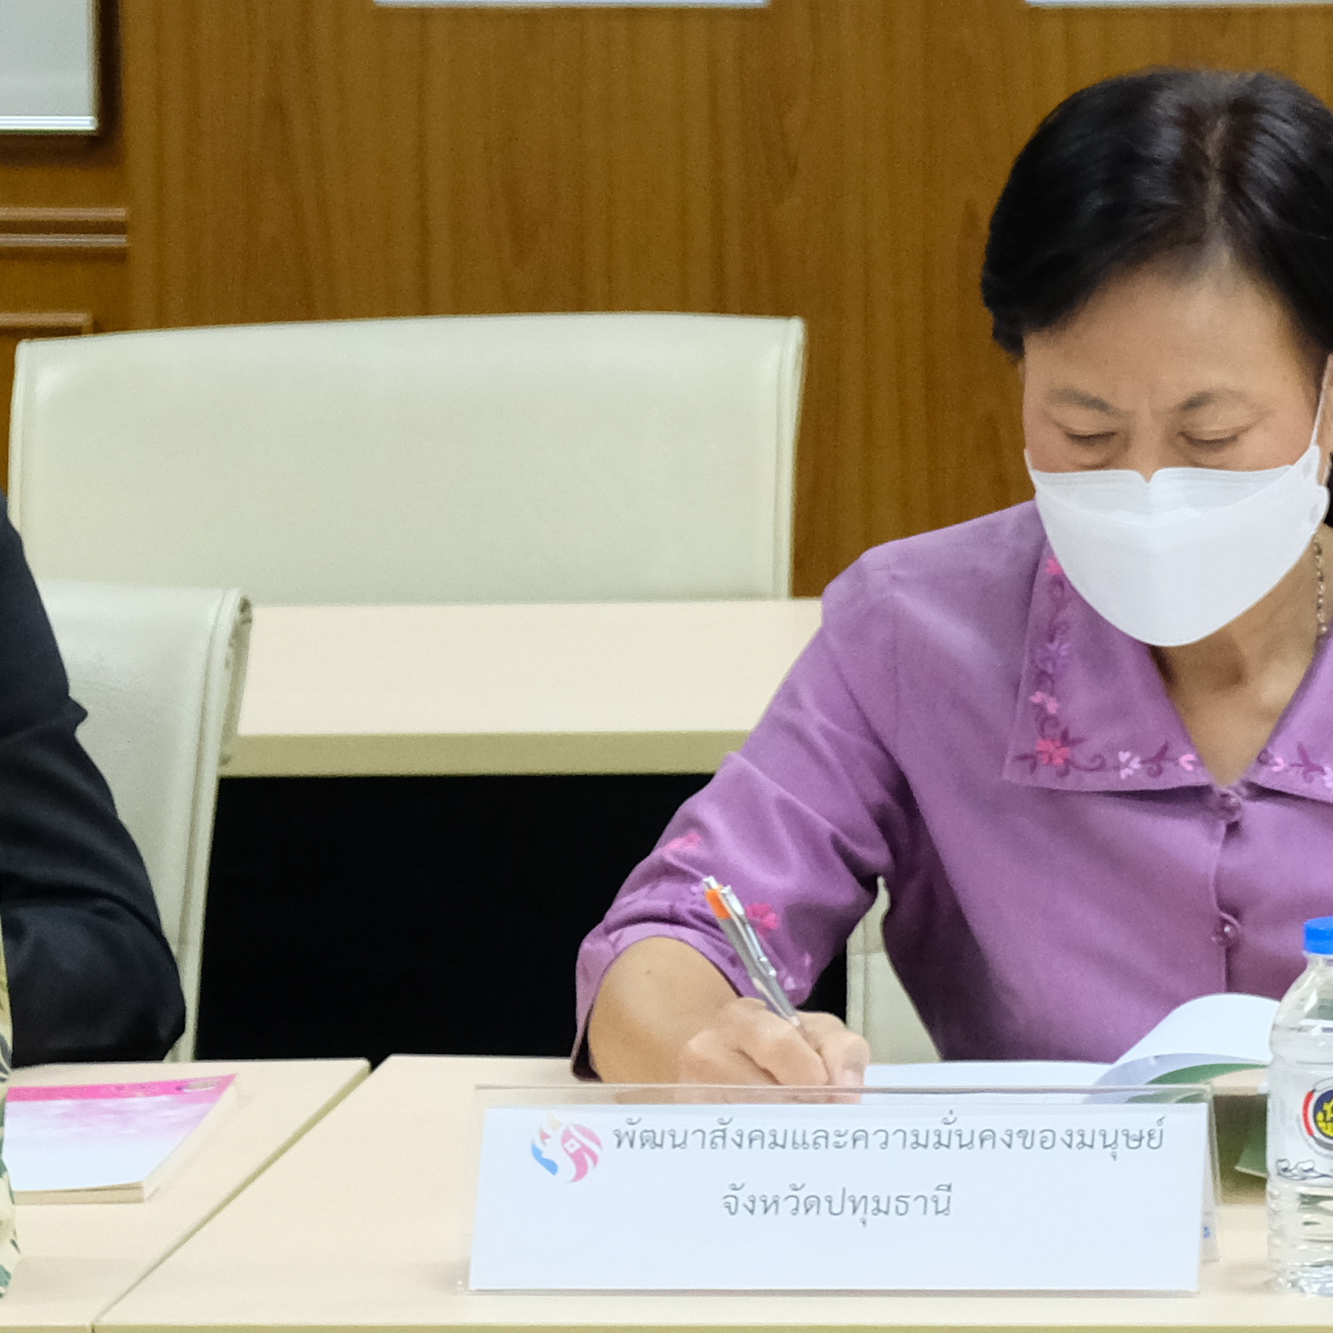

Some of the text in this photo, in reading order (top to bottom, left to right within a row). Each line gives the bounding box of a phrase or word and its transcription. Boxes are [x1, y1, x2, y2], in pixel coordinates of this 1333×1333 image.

[612, 1109, 1167, 1162] พัฒนาสังคมและความมั่นคงของมนุษย์
[721, 1183, 954, 1227] จังหวัดปทุมธานี
